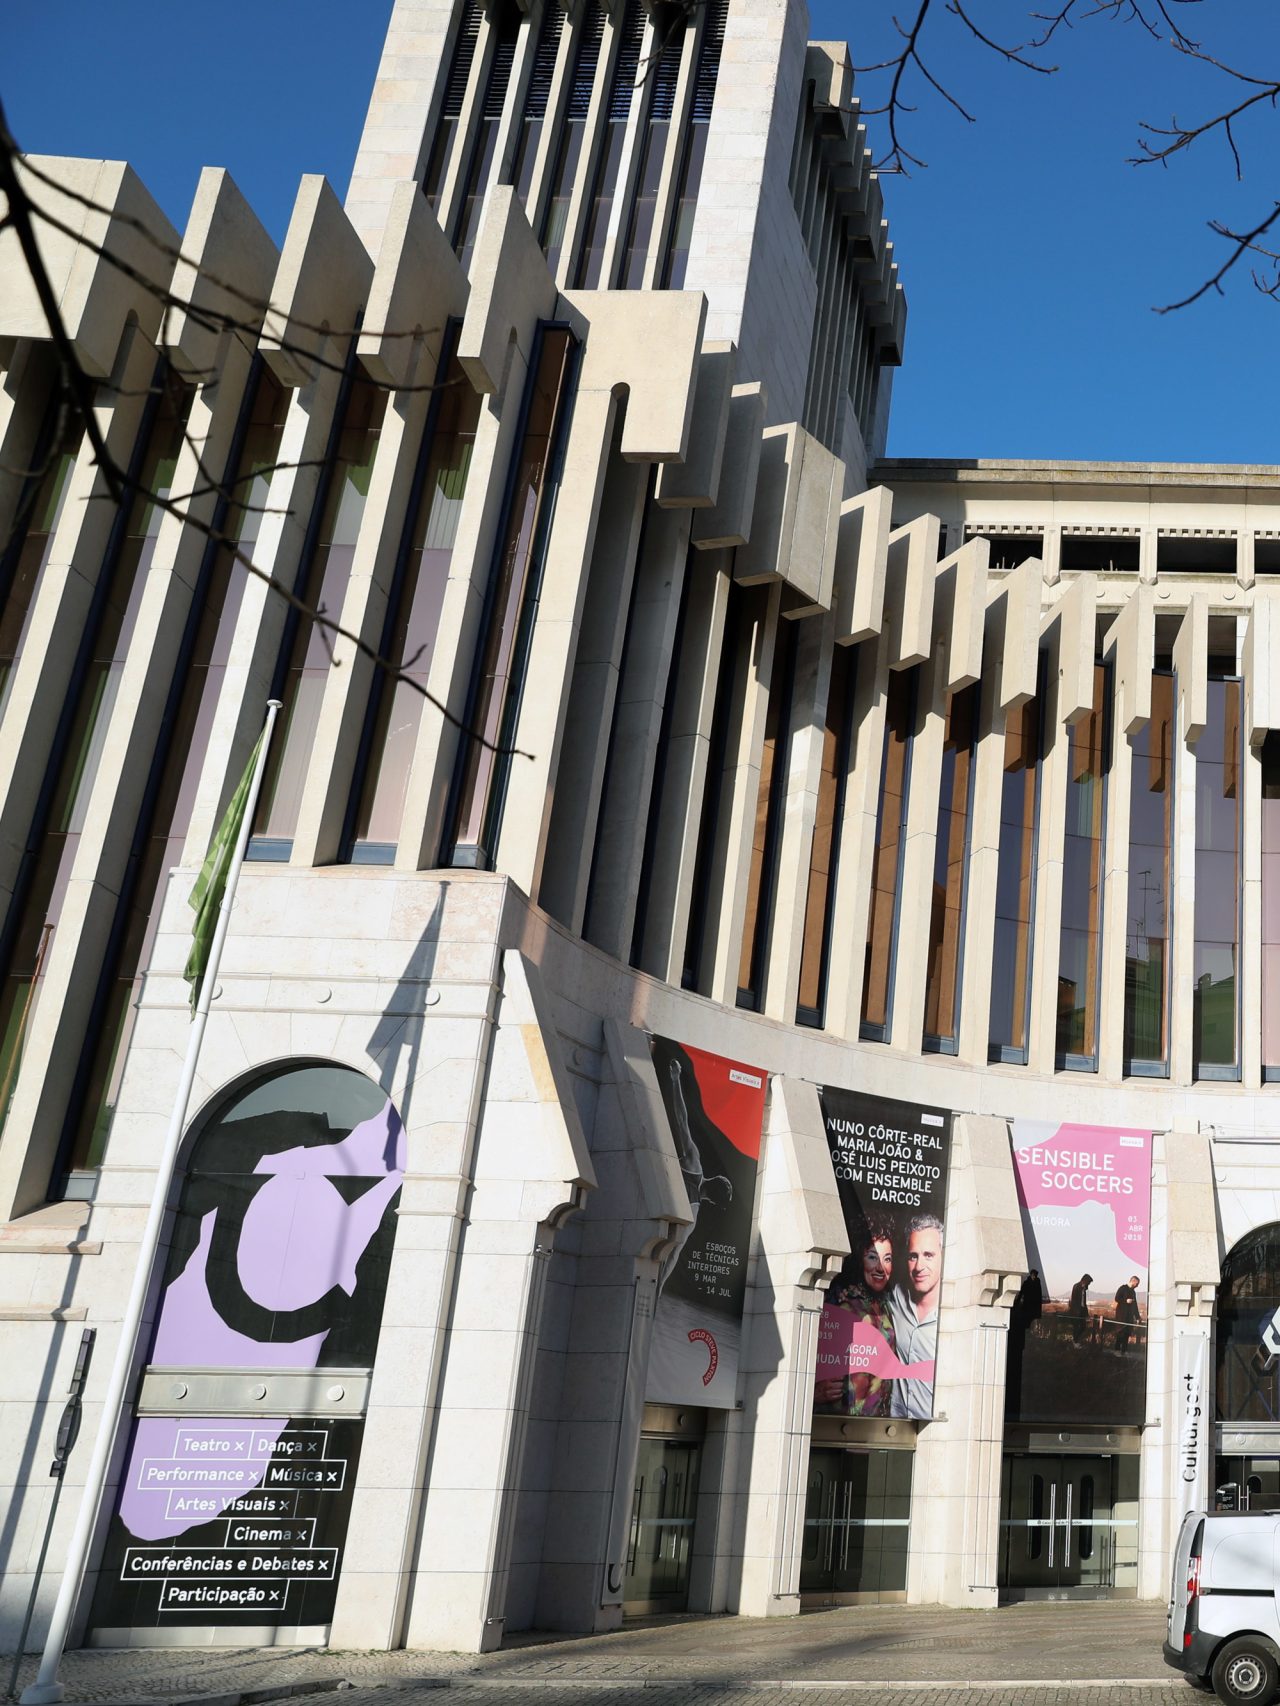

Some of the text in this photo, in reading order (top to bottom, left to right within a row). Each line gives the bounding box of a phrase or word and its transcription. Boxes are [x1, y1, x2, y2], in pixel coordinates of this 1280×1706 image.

[826, 1118, 943, 1150] NUNO CÔRTE-REAL
[837, 1135, 923, 1161] MARIA JOÃO &
[832, 1150, 940, 1179] OSÉ LUIS PEIXOTO
[1018, 1147, 1115, 1171] SENSIBLE
[835, 1166, 932, 1193] COM ENSEMBLE
[1041, 1171, 1133, 1194] SOCCERS
[872, 1188, 920, 1207] DARCOS
[1030, 1216, 1071, 1227] AURORA
[706, 1242, 736, 1255] ESBOÇOS
[692, 1250, 740, 1266] DE TÉCNICAS
[688, 1260, 730, 1275] INTERIORES
[694, 1273, 717, 1283] 9 MAR
[706, 1286, 715, 1294] 14
[719, 1287, 732, 1297] JUL
[824, 1321, 840, 1330] MAR
[690, 1331, 706, 1340] CICLO
[845, 1344, 878, 1356] AGORA
[817, 1353, 870, 1367] UDA TUDO
[183, 1438, 230, 1452] Teatro
[257, 1438, 302, 1455] Dança
[147, 1467, 244, 1481] Performance
[270, 1467, 323, 1482] Música
[174, 1497, 216, 1511] Artes
[222, 1497, 276, 1511] Visuais
[234, 1527, 291, 1541] Cinema
[131, 1555, 232, 1572] Conferências
[237, 1561, 247, 1572] e
[252, 1557, 314, 1572] Debates
[168, 1587, 265, 1603] Participação
